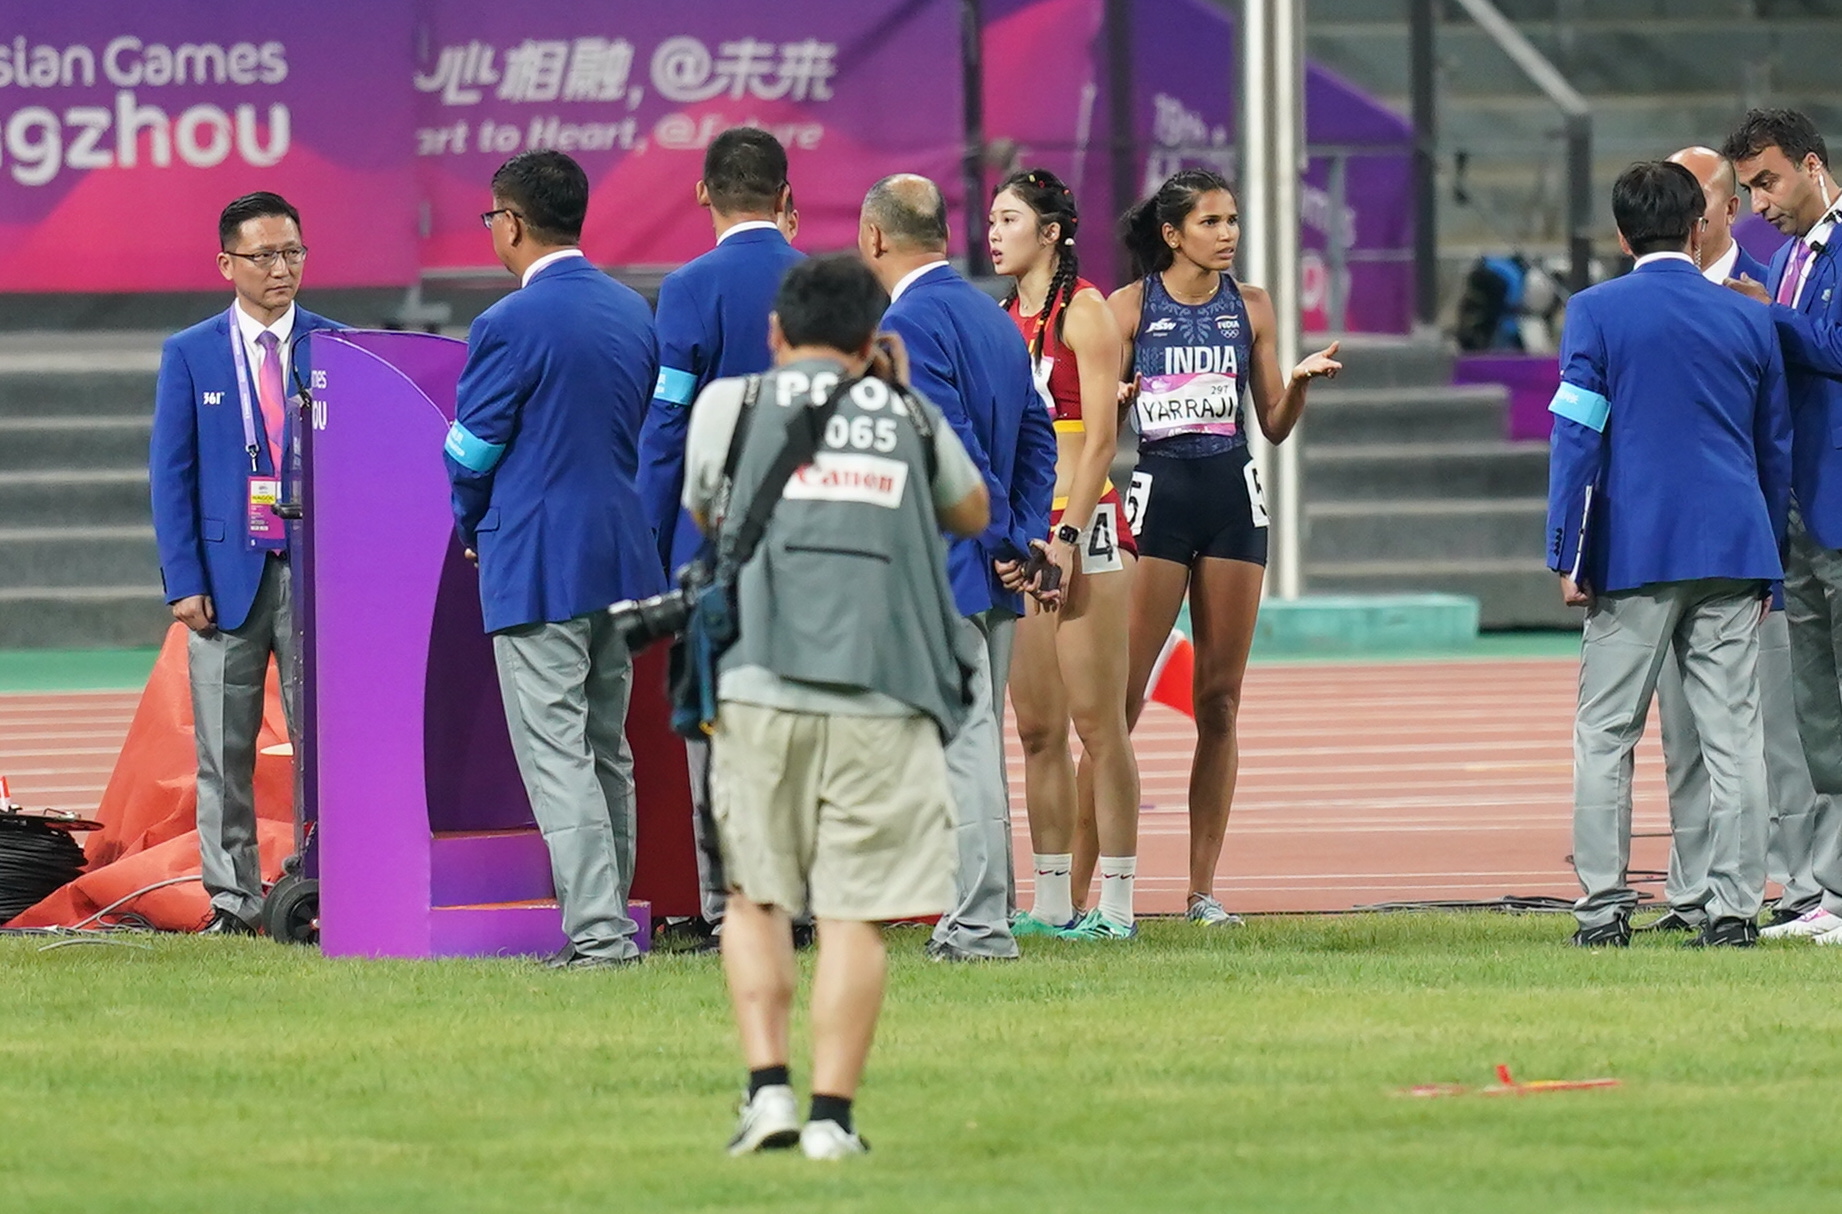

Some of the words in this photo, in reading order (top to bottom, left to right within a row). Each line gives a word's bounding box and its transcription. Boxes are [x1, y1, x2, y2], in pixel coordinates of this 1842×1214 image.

[103, 35, 289, 88] Games
[0, 90, 290, 186] gzhou
[479, 118, 521, 153] to
[1217, 320, 1240, 330] INDIA
[1165, 345, 1238, 375] INDIA
[1211, 385, 1229, 396] 297
[1142, 396, 1234, 424] YARRAJI
[825, 414, 898, 453] 065
[1088, 512, 1113, 562] 4
